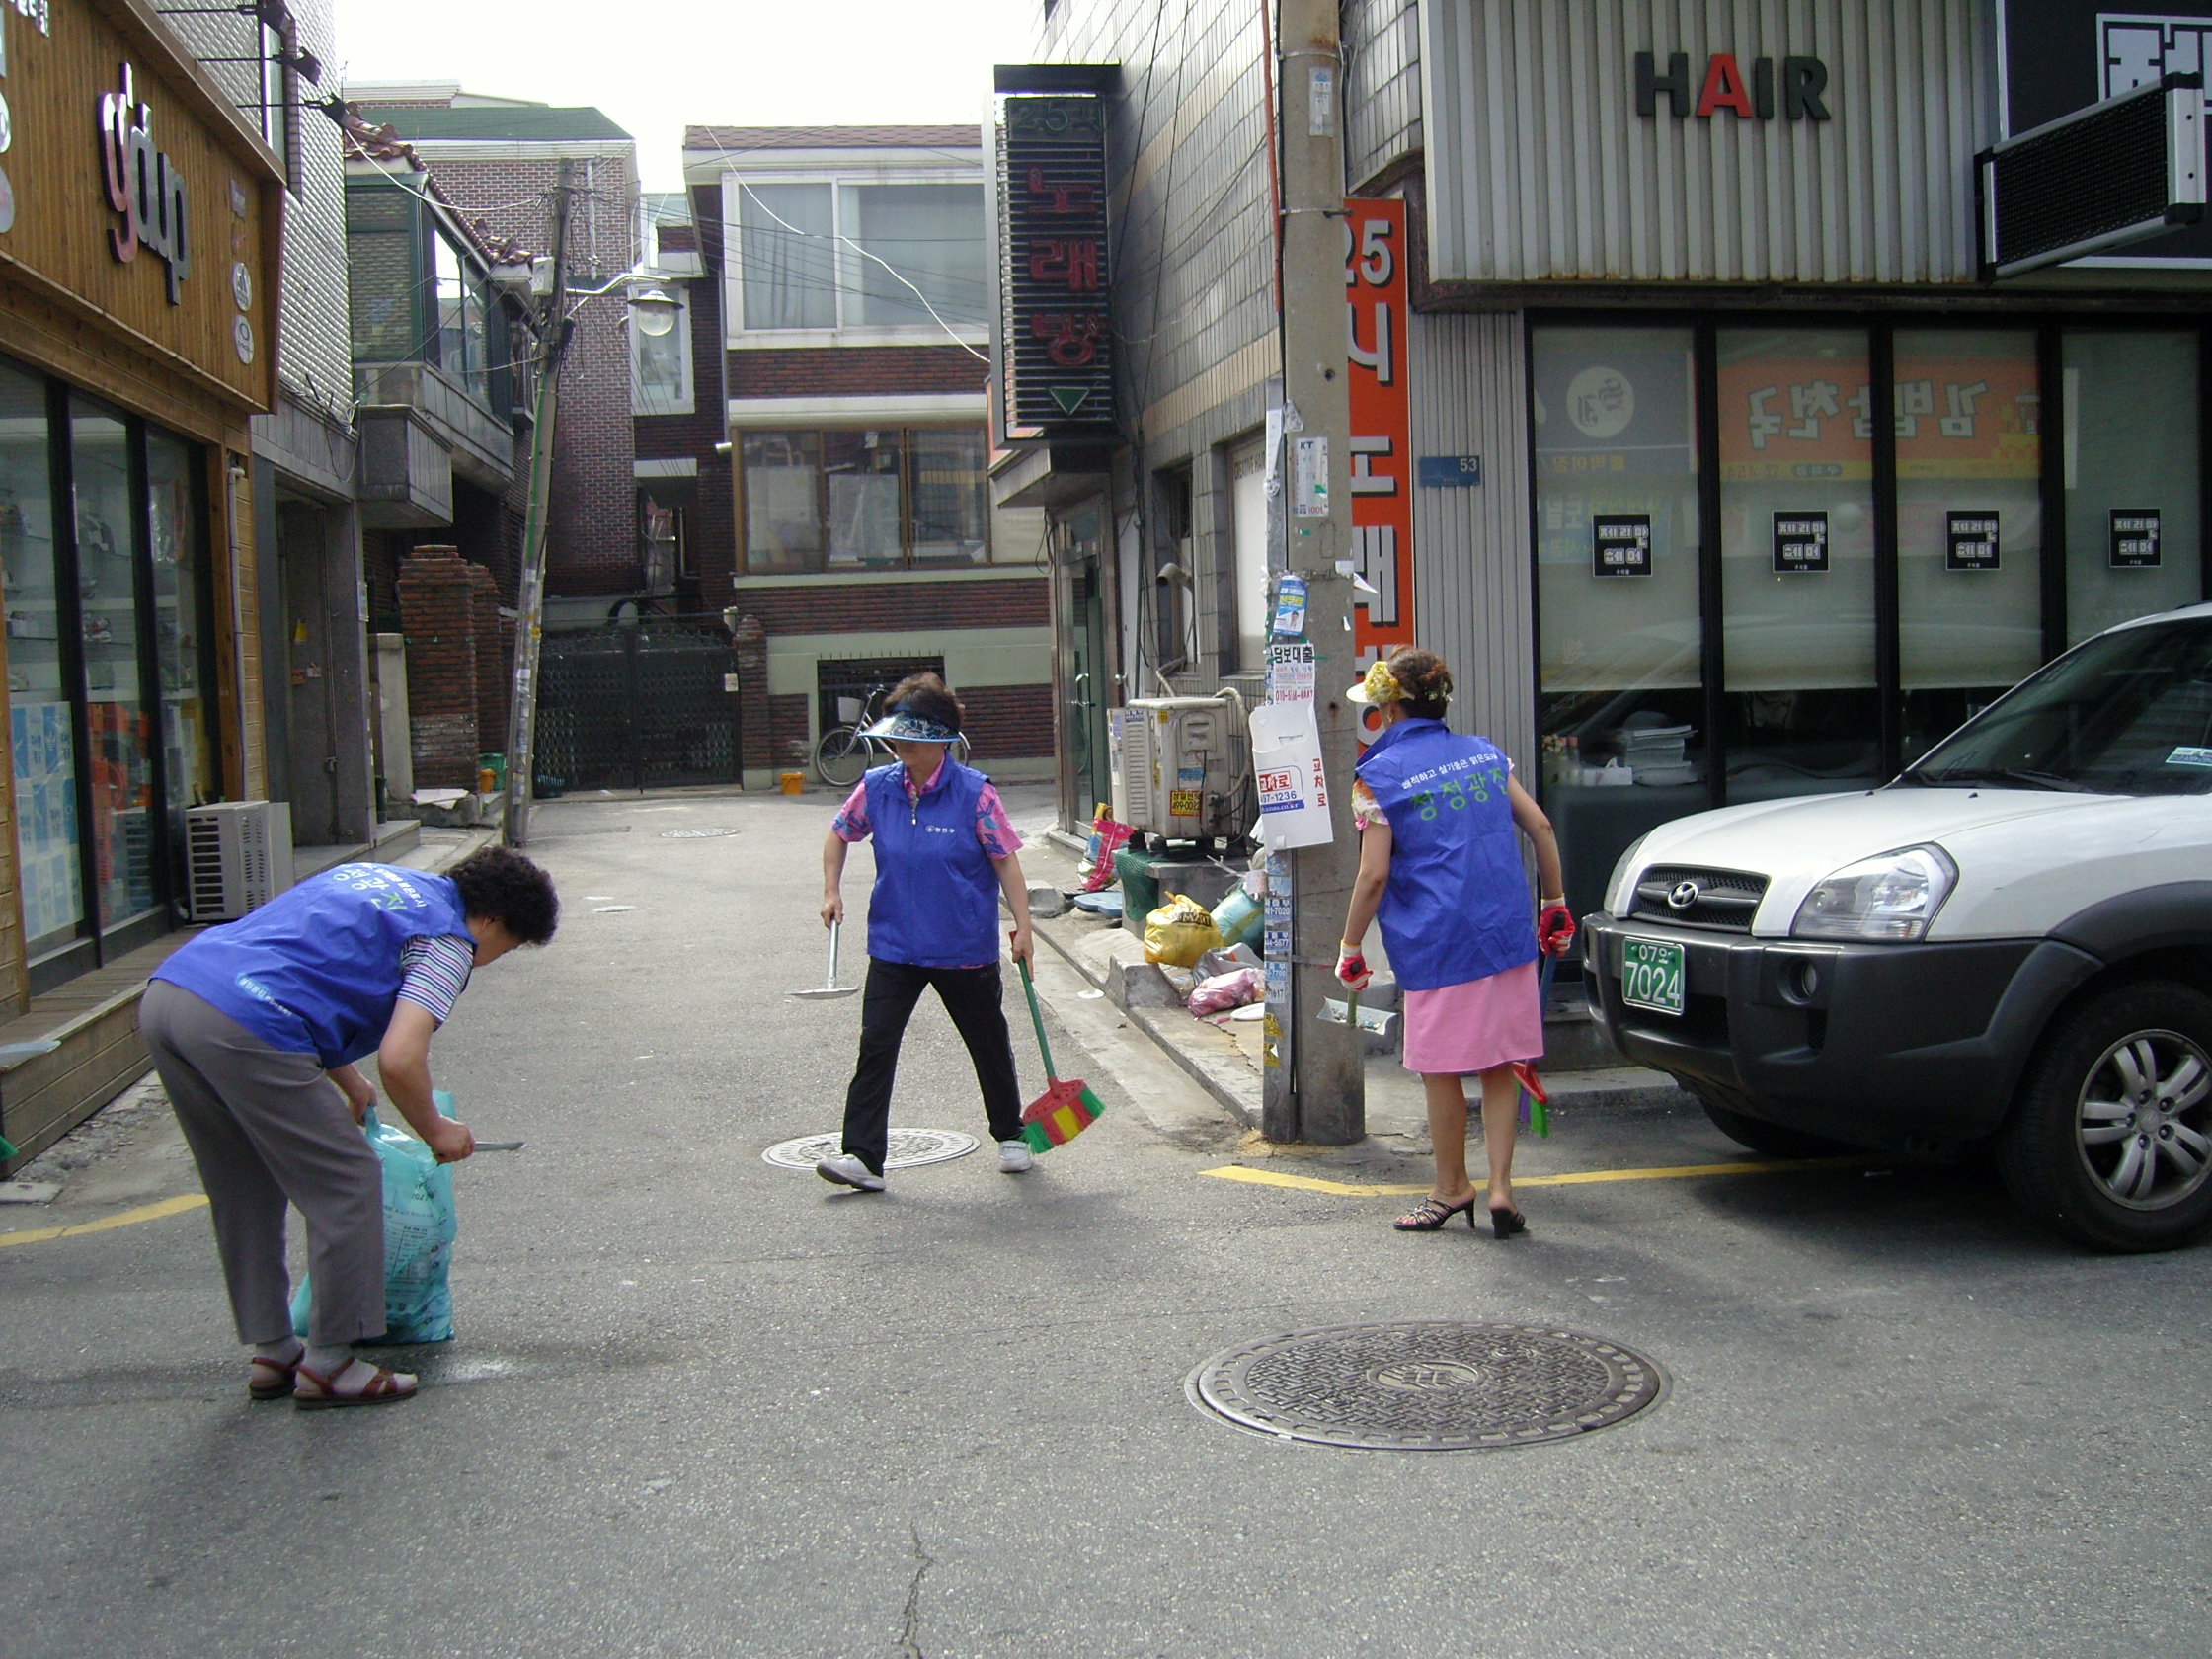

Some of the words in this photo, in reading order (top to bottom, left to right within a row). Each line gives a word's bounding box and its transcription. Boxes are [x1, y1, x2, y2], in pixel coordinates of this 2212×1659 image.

[1635, 52, 1831, 119] HAIR
[1027, 165, 1108, 366] 노래방
[1300, 441, 1314, 450] KT
[1460, 457, 1478, 472] 53
[1604, 548, 1643, 564] 헤어
[1783, 544, 1820, 560] 헤어
[1956, 542, 1992, 558] 헤어
[2119, 540, 2154, 555] 헤어
[1274, 645, 1313, 664] 담보대출
[1312, 757, 1327, 808] 교차로
[1638, 944, 1669, 965] 07오
[1624, 961, 1681, 1007] 7024
